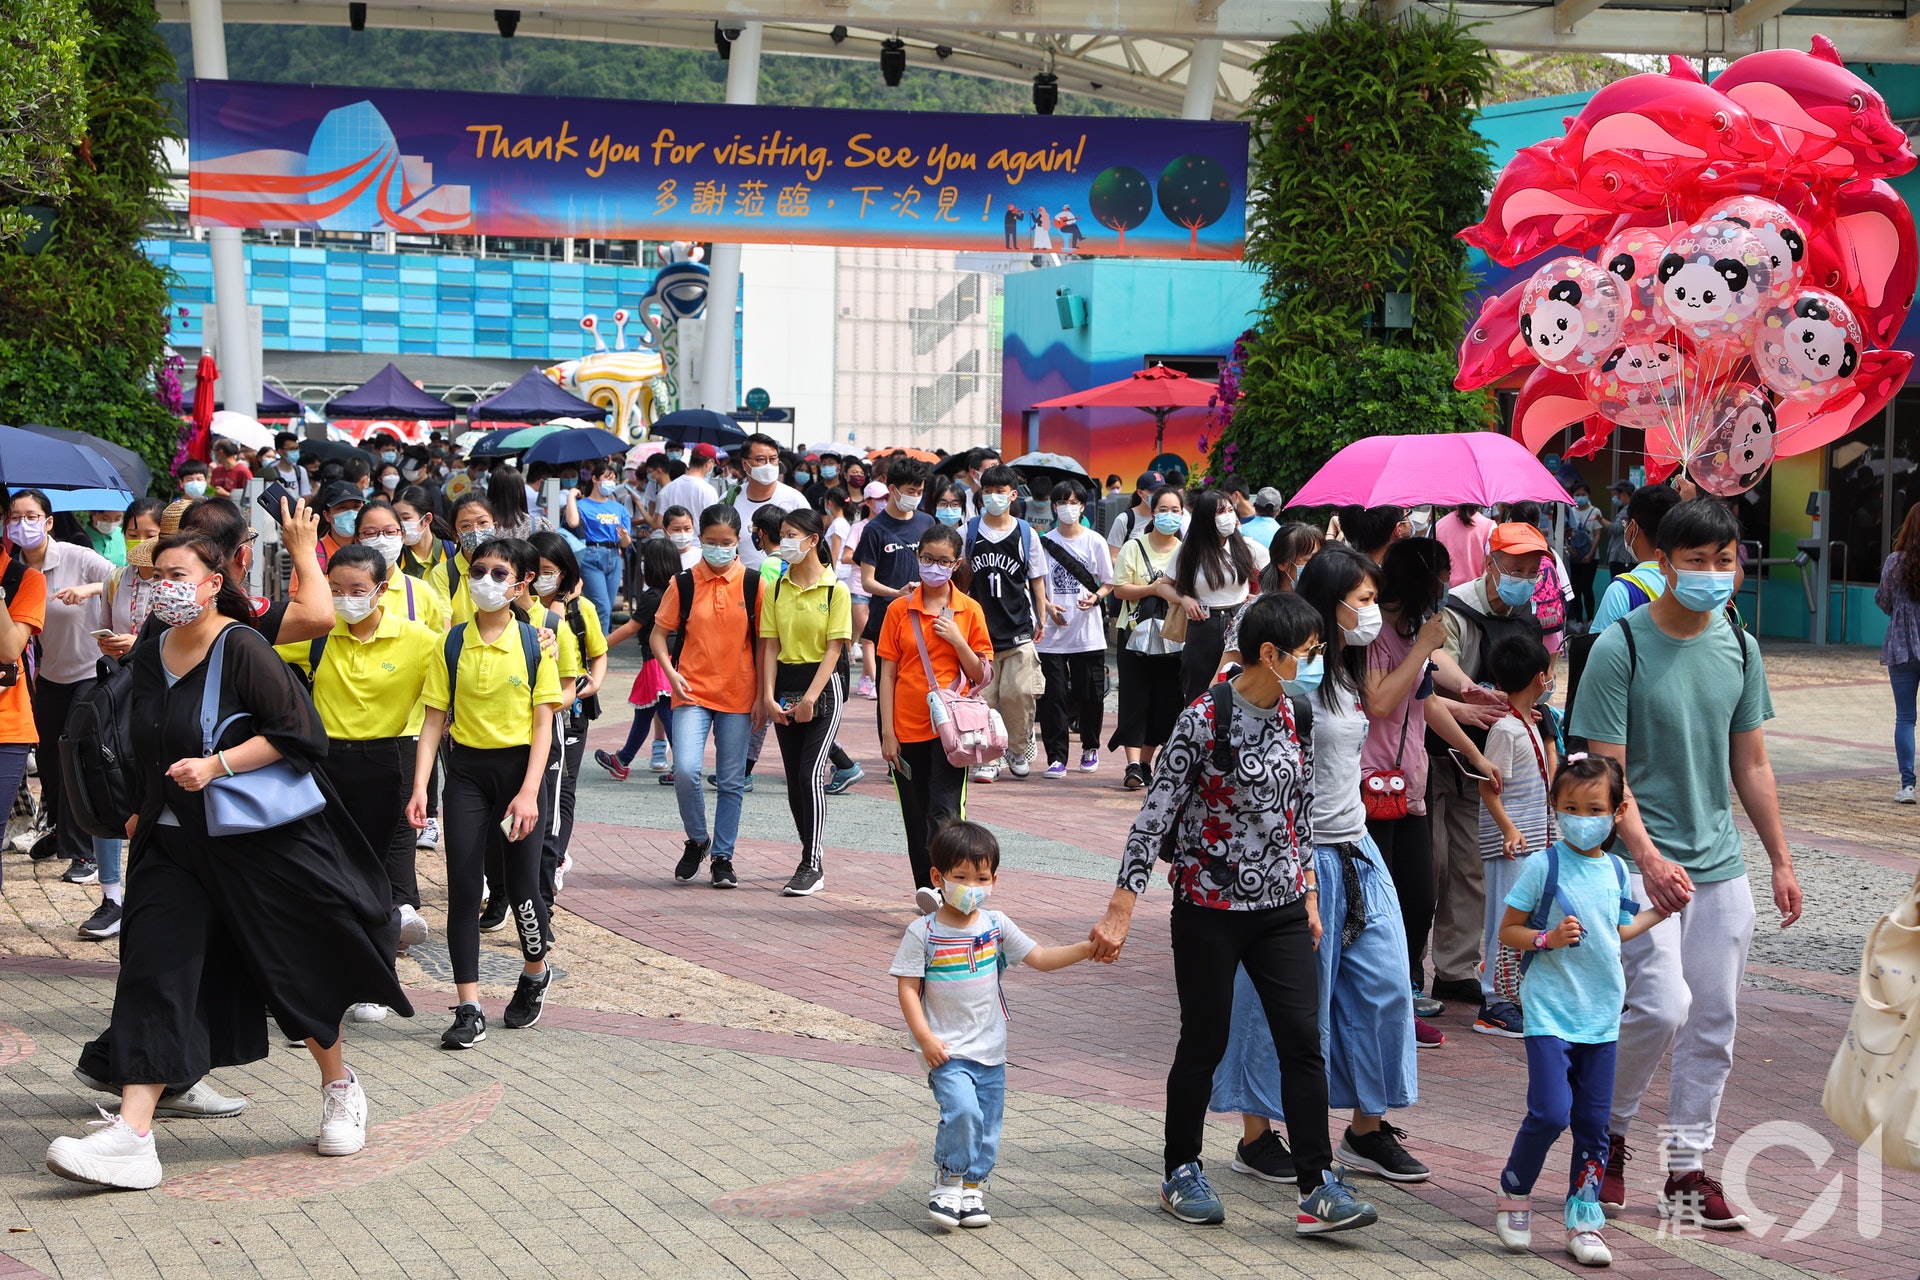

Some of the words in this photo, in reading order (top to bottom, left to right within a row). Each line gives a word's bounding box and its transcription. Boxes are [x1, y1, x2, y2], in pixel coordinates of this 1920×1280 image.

[466, 120, 578, 162] Thank
[585, 134, 640, 178] you
[651, 128, 705, 166] for
[713, 130, 833, 181] visiting.
[844, 133, 919, 168] See
[923, 143, 976, 185] you
[987, 134, 1087, 185] again!
[971, 552, 1020, 576] BROOKLYN
[987, 572, 1002, 598] 11
[518, 898, 542, 955] adidas
